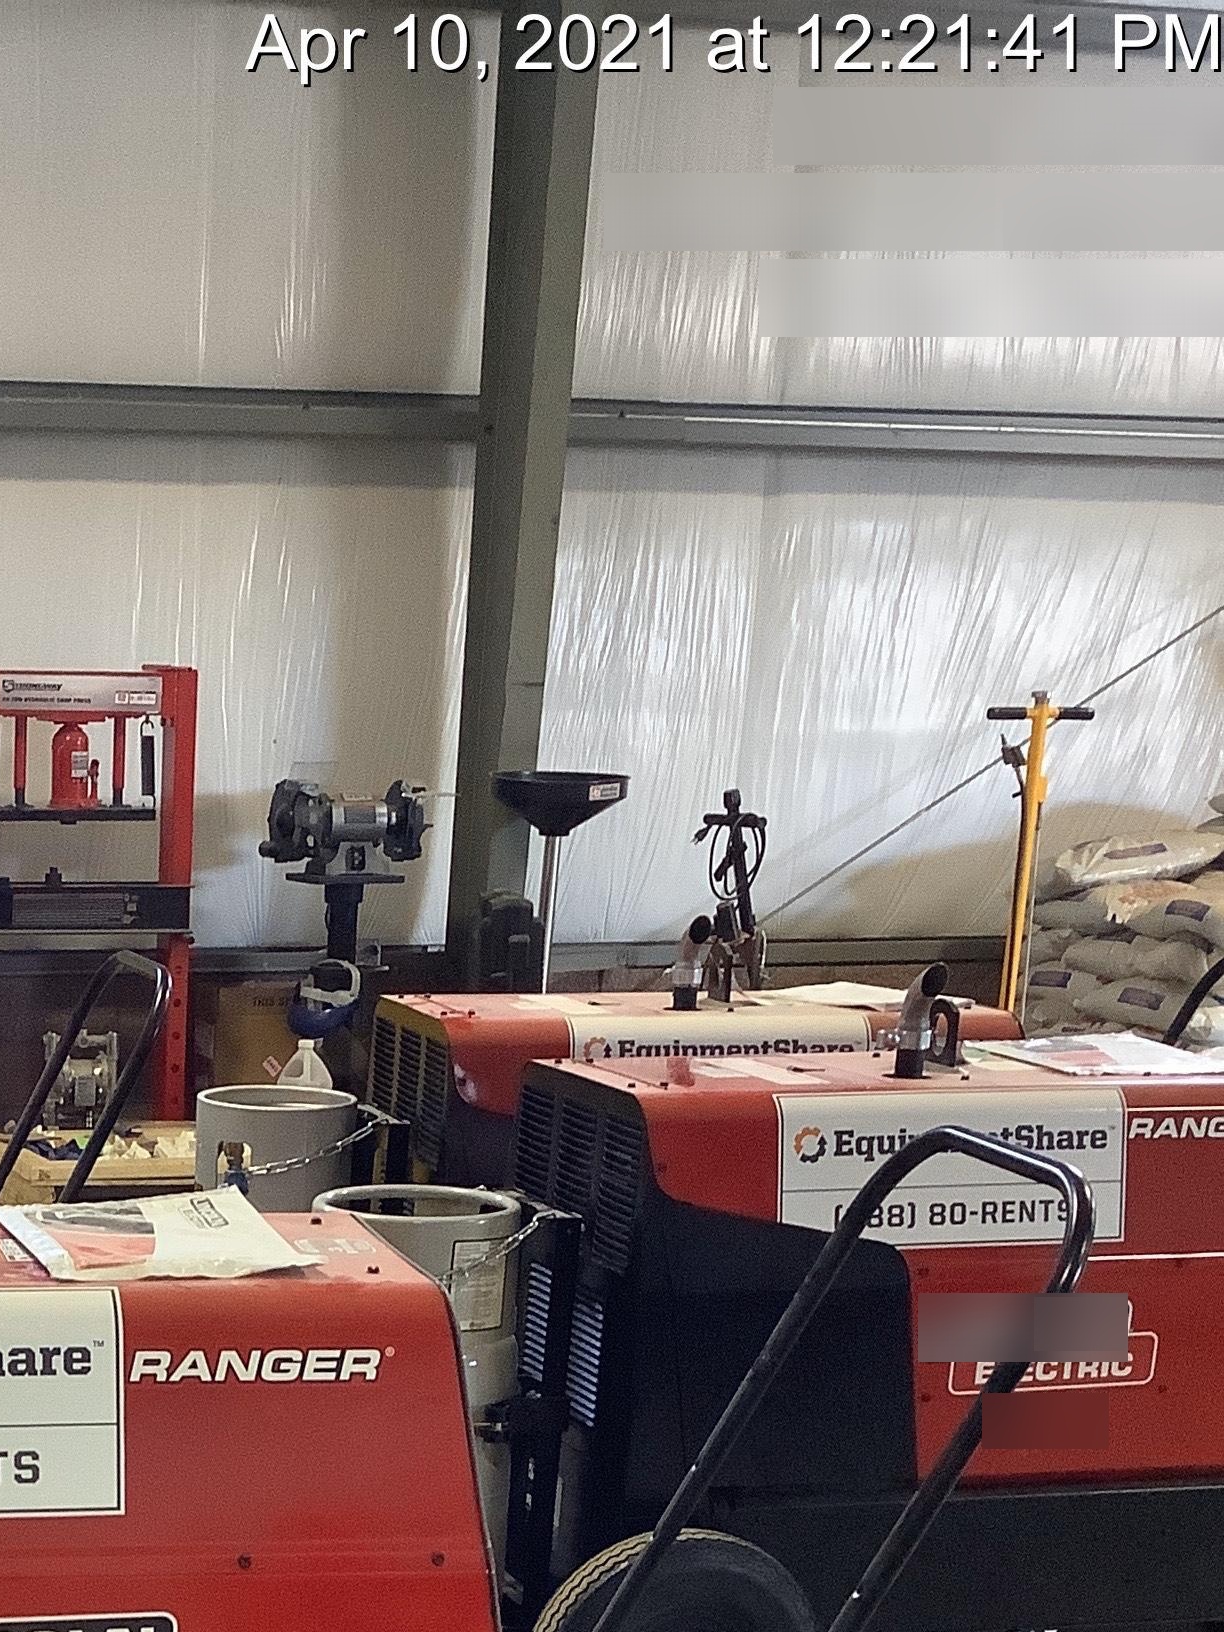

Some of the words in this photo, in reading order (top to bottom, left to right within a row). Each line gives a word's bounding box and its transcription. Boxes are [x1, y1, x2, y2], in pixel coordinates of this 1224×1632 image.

[833, 1123, 1108, 1162] EquitShare
[834, 1202, 916, 1229] (88)
[129, 1349, 381, 1382] RANGER
[974, 1352, 1134, 1385] ECTRIC
